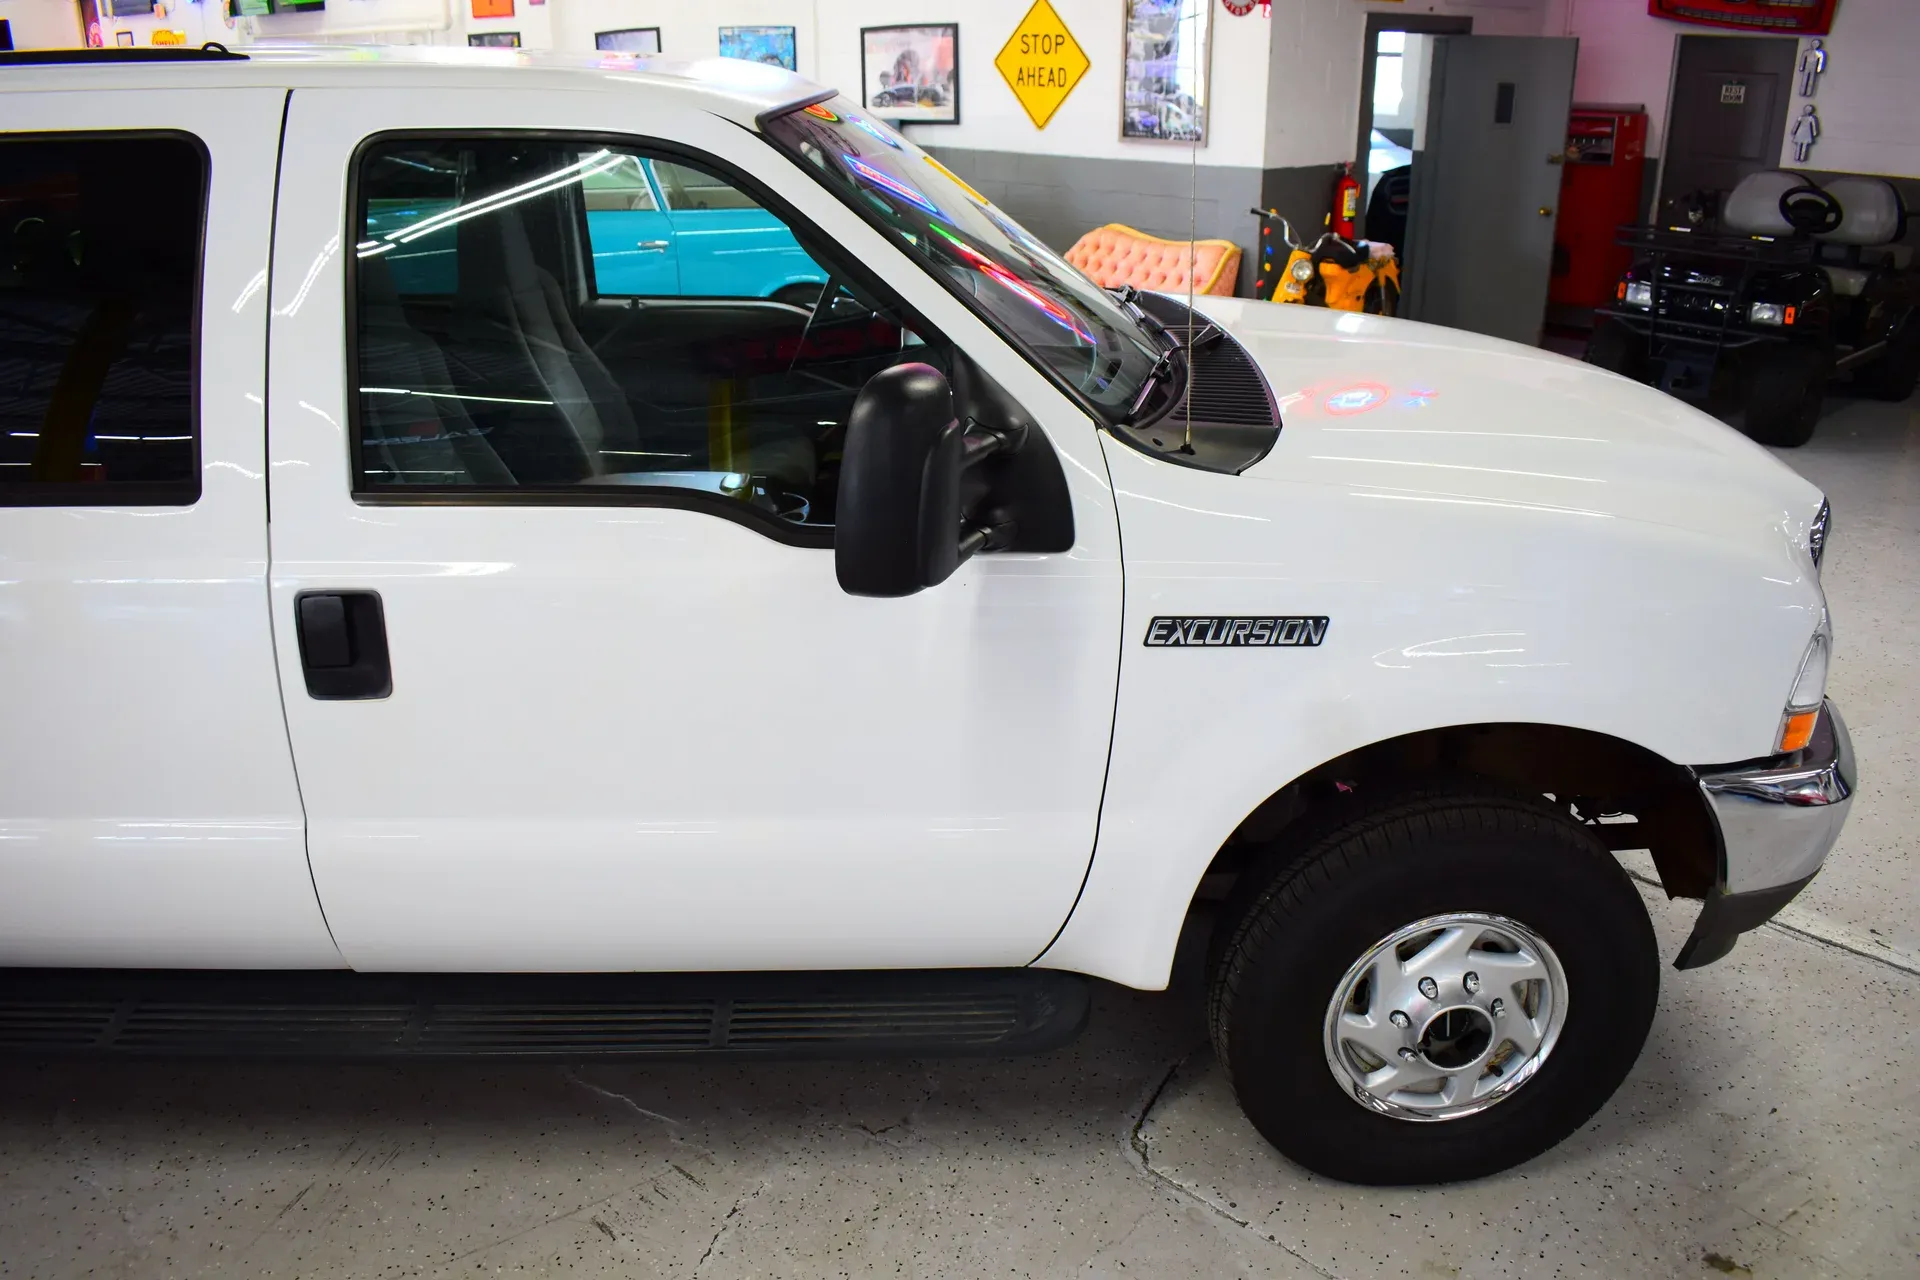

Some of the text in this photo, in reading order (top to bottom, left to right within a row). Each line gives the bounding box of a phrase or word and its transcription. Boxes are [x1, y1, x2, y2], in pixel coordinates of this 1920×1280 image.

[1020, 34, 1065, 54] STOP
[1016, 67, 1067, 88] AHEAD
[1724, 86, 1742, 94] REST
[1147, 619, 1327, 645] EXCURSION
